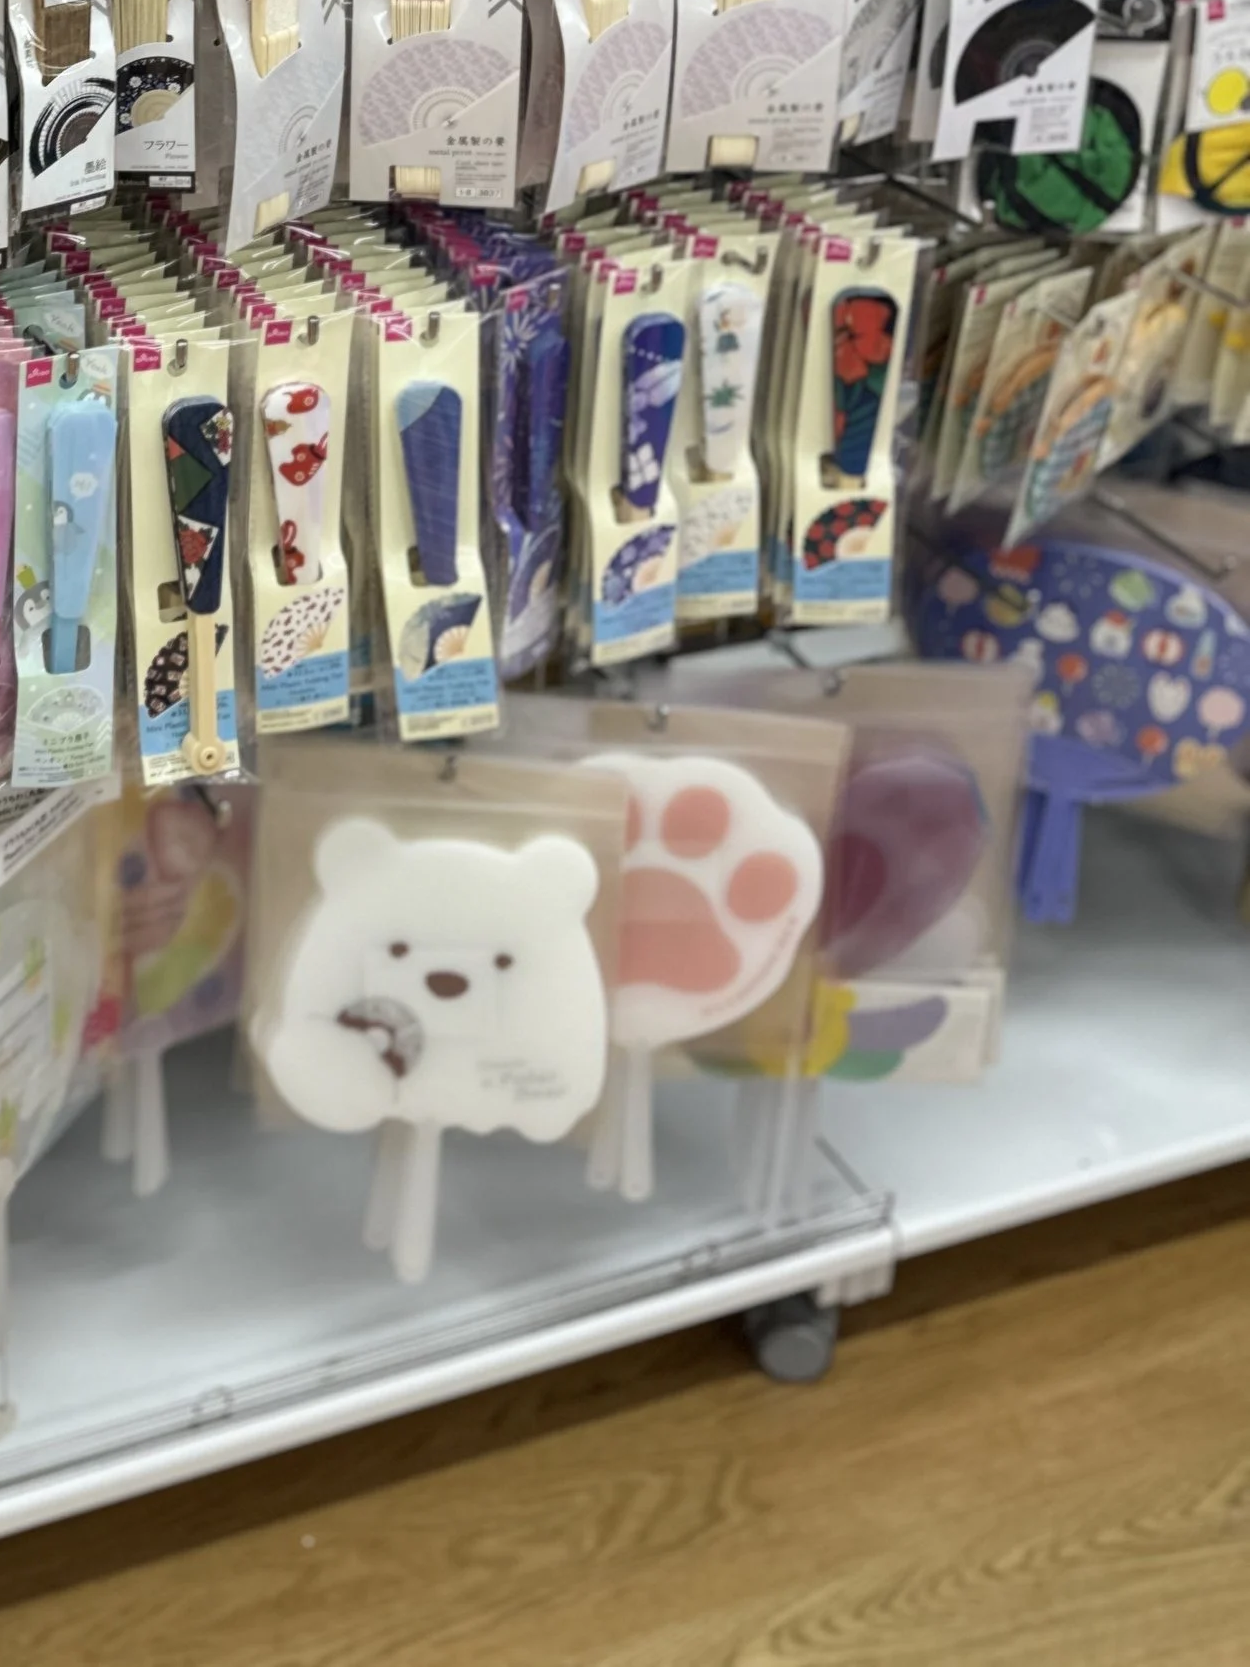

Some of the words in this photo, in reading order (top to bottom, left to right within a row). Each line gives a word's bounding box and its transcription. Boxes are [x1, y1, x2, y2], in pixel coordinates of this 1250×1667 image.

[143, 140, 189, 152] フラワー
[446, 135, 505, 147] 金属製の要
[49, 315, 76, 333] Yeah
[85, 356, 112, 375] Yeah
